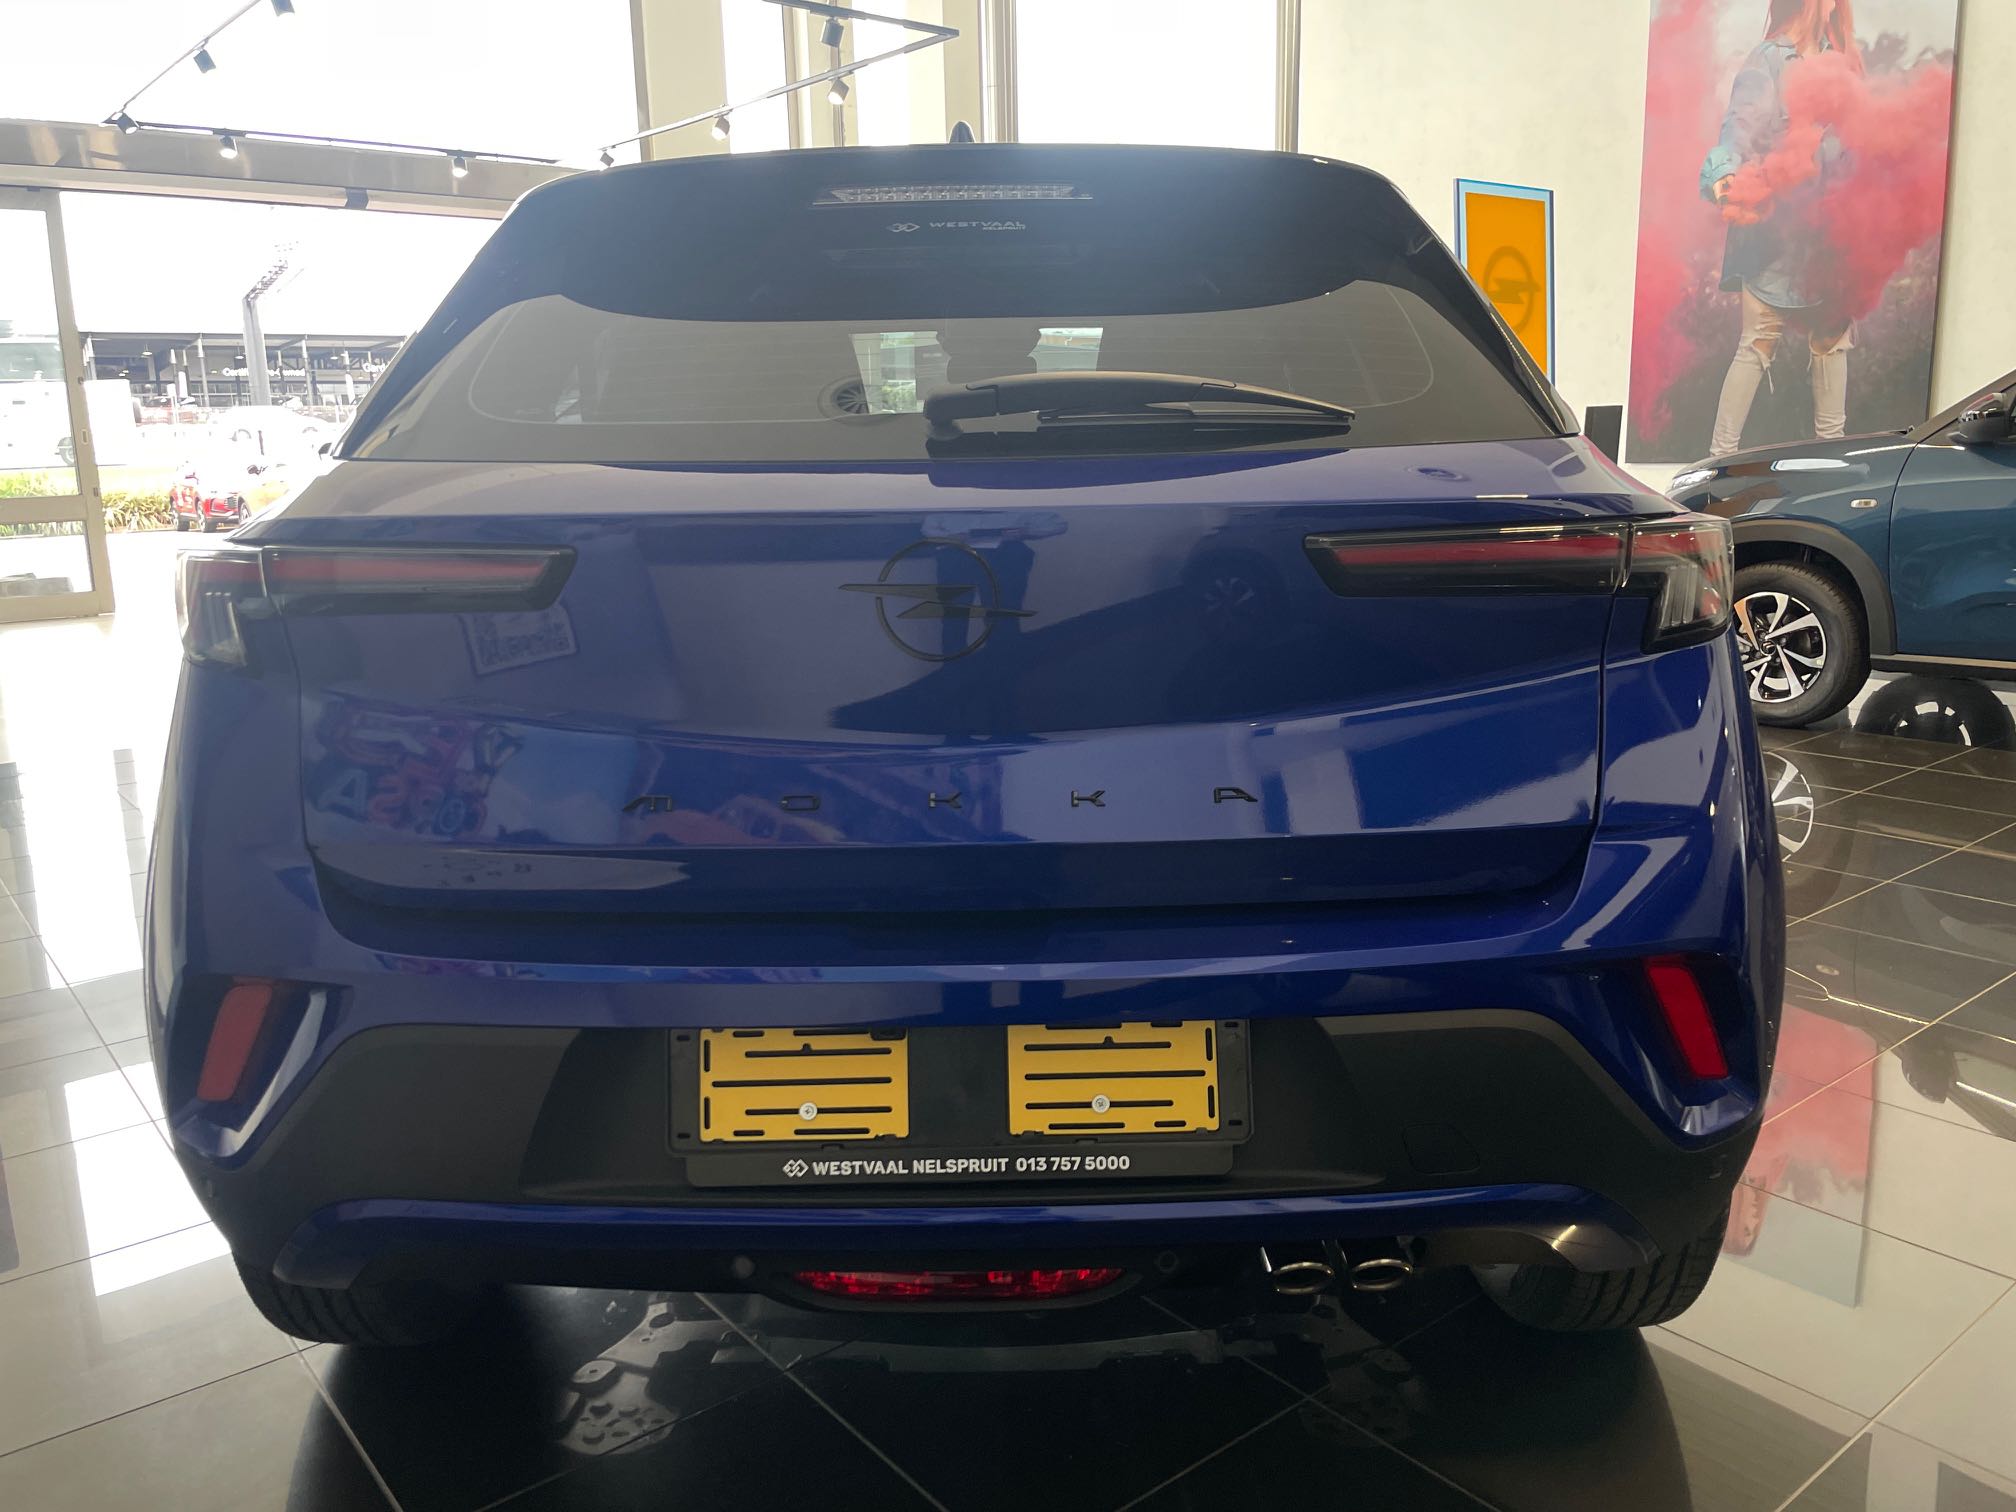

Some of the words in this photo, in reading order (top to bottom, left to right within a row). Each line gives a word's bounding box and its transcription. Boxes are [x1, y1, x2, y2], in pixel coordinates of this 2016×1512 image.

[622, 786, 1259, 812] MOKKA
[812, 1160, 909, 1176] WESTVAAL
[912, 1157, 1009, 1174] NELSPRUIT
[1015, 1157, 1047, 1172] 013
[1050, 1156, 1082, 1171] 757
[1084, 1155, 1131, 1171] 5000
